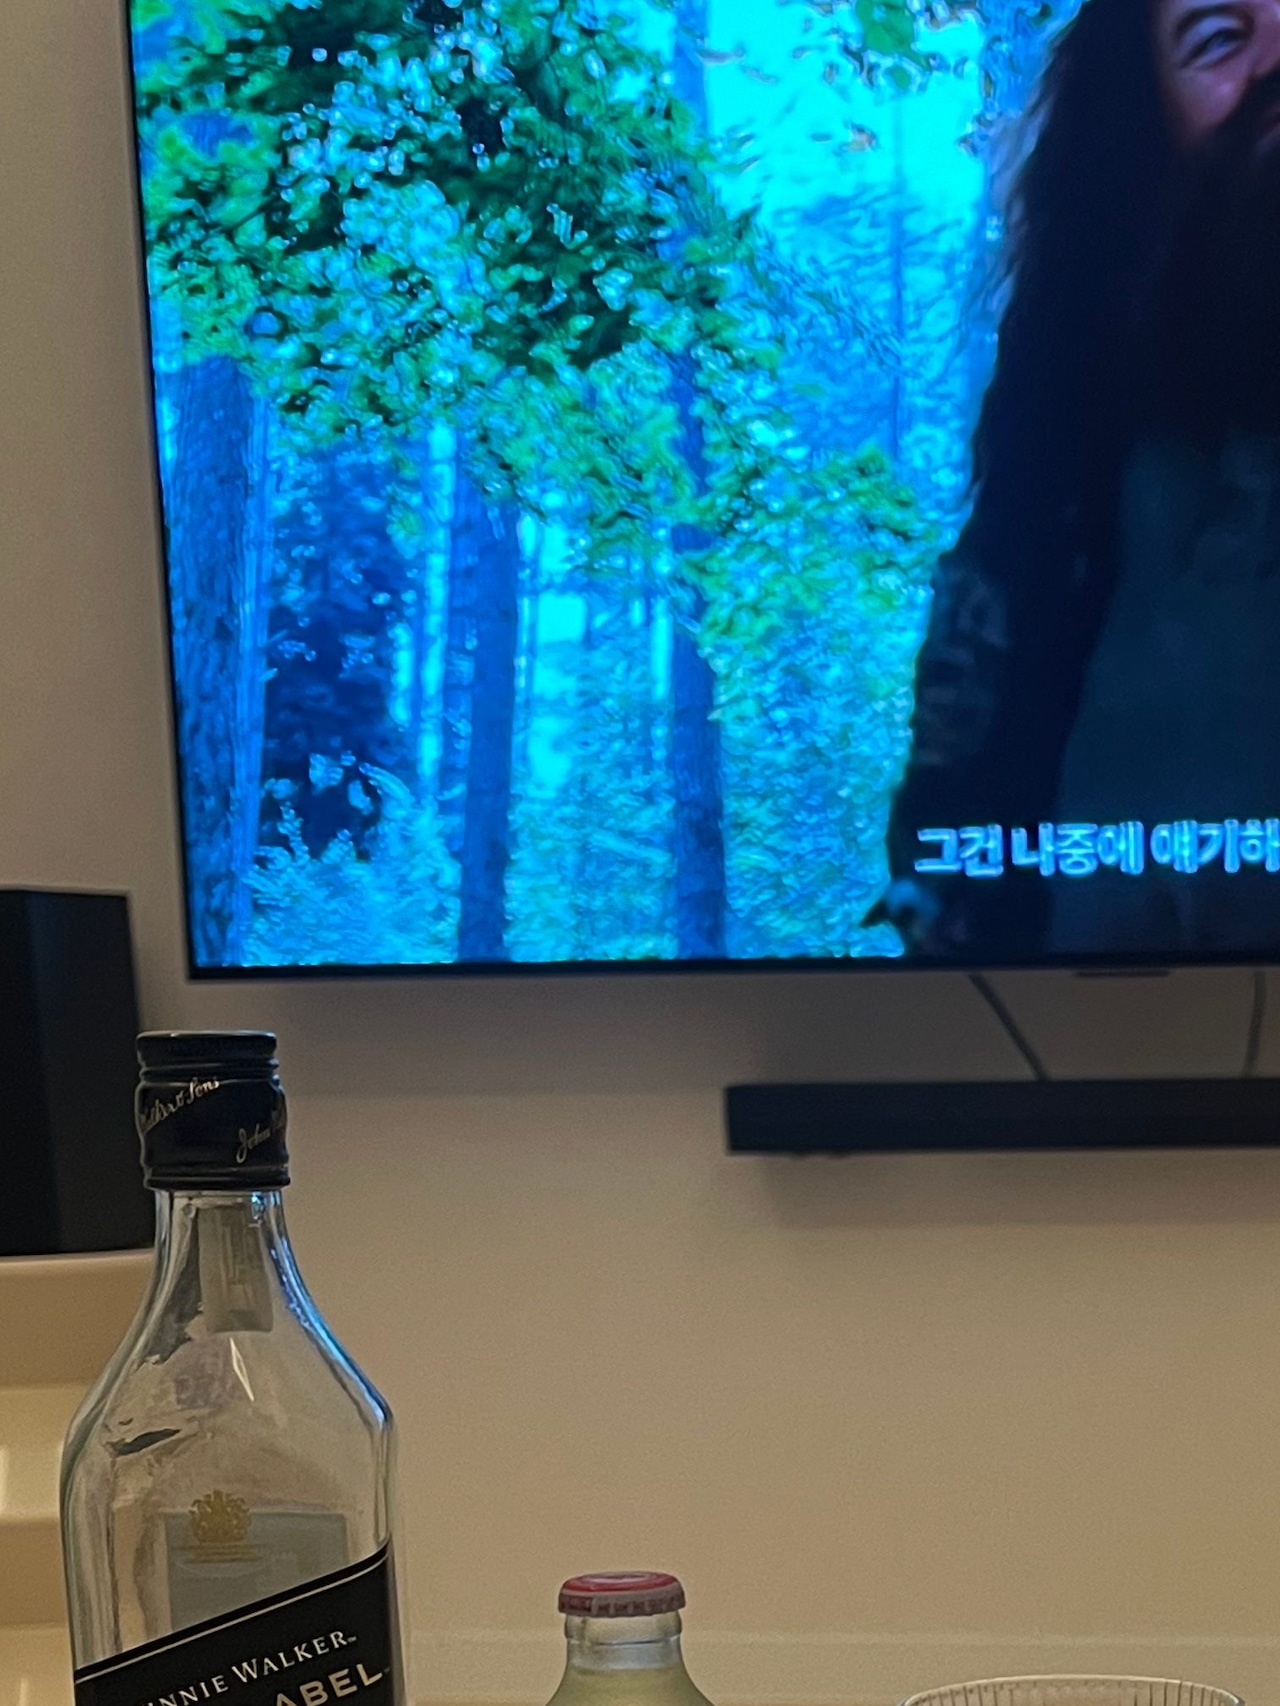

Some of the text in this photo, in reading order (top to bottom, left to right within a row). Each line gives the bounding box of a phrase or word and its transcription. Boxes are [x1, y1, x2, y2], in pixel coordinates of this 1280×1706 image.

[914, 823, 1004, 877] 그건
[1011, 819, 1144, 876] 나중에
[232, 1631, 346, 1684] WALKER
